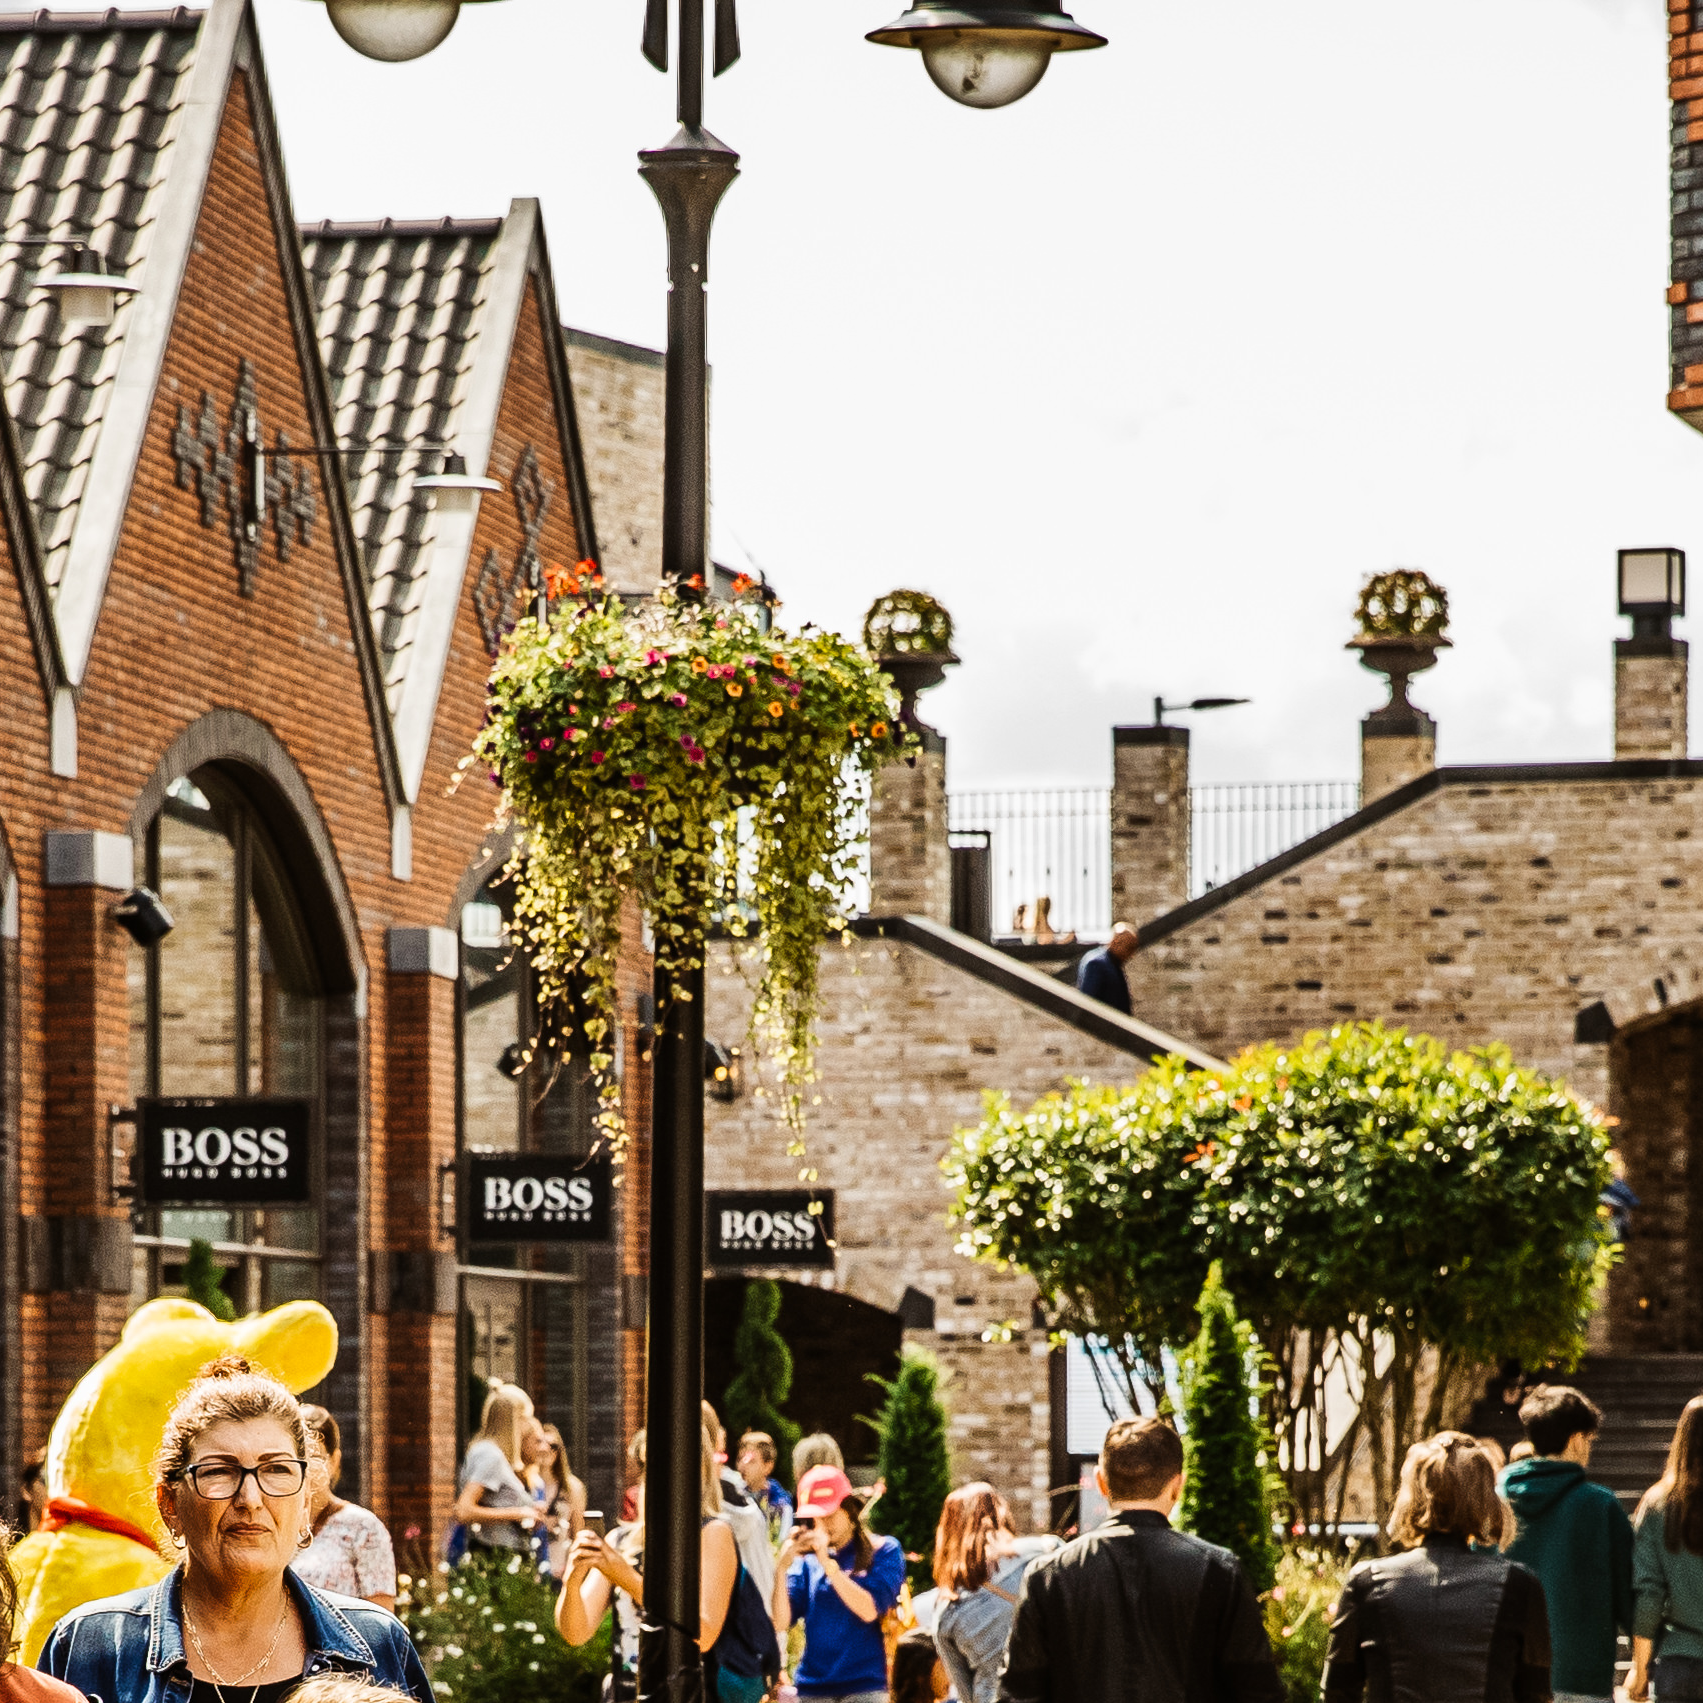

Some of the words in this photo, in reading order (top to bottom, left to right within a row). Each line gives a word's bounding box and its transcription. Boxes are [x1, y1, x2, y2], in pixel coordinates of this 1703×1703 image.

[161, 1127, 289, 1166] BOSS
[484, 1176, 594, 1211] BOSS
[720, 1210, 816, 1241] BOSS
